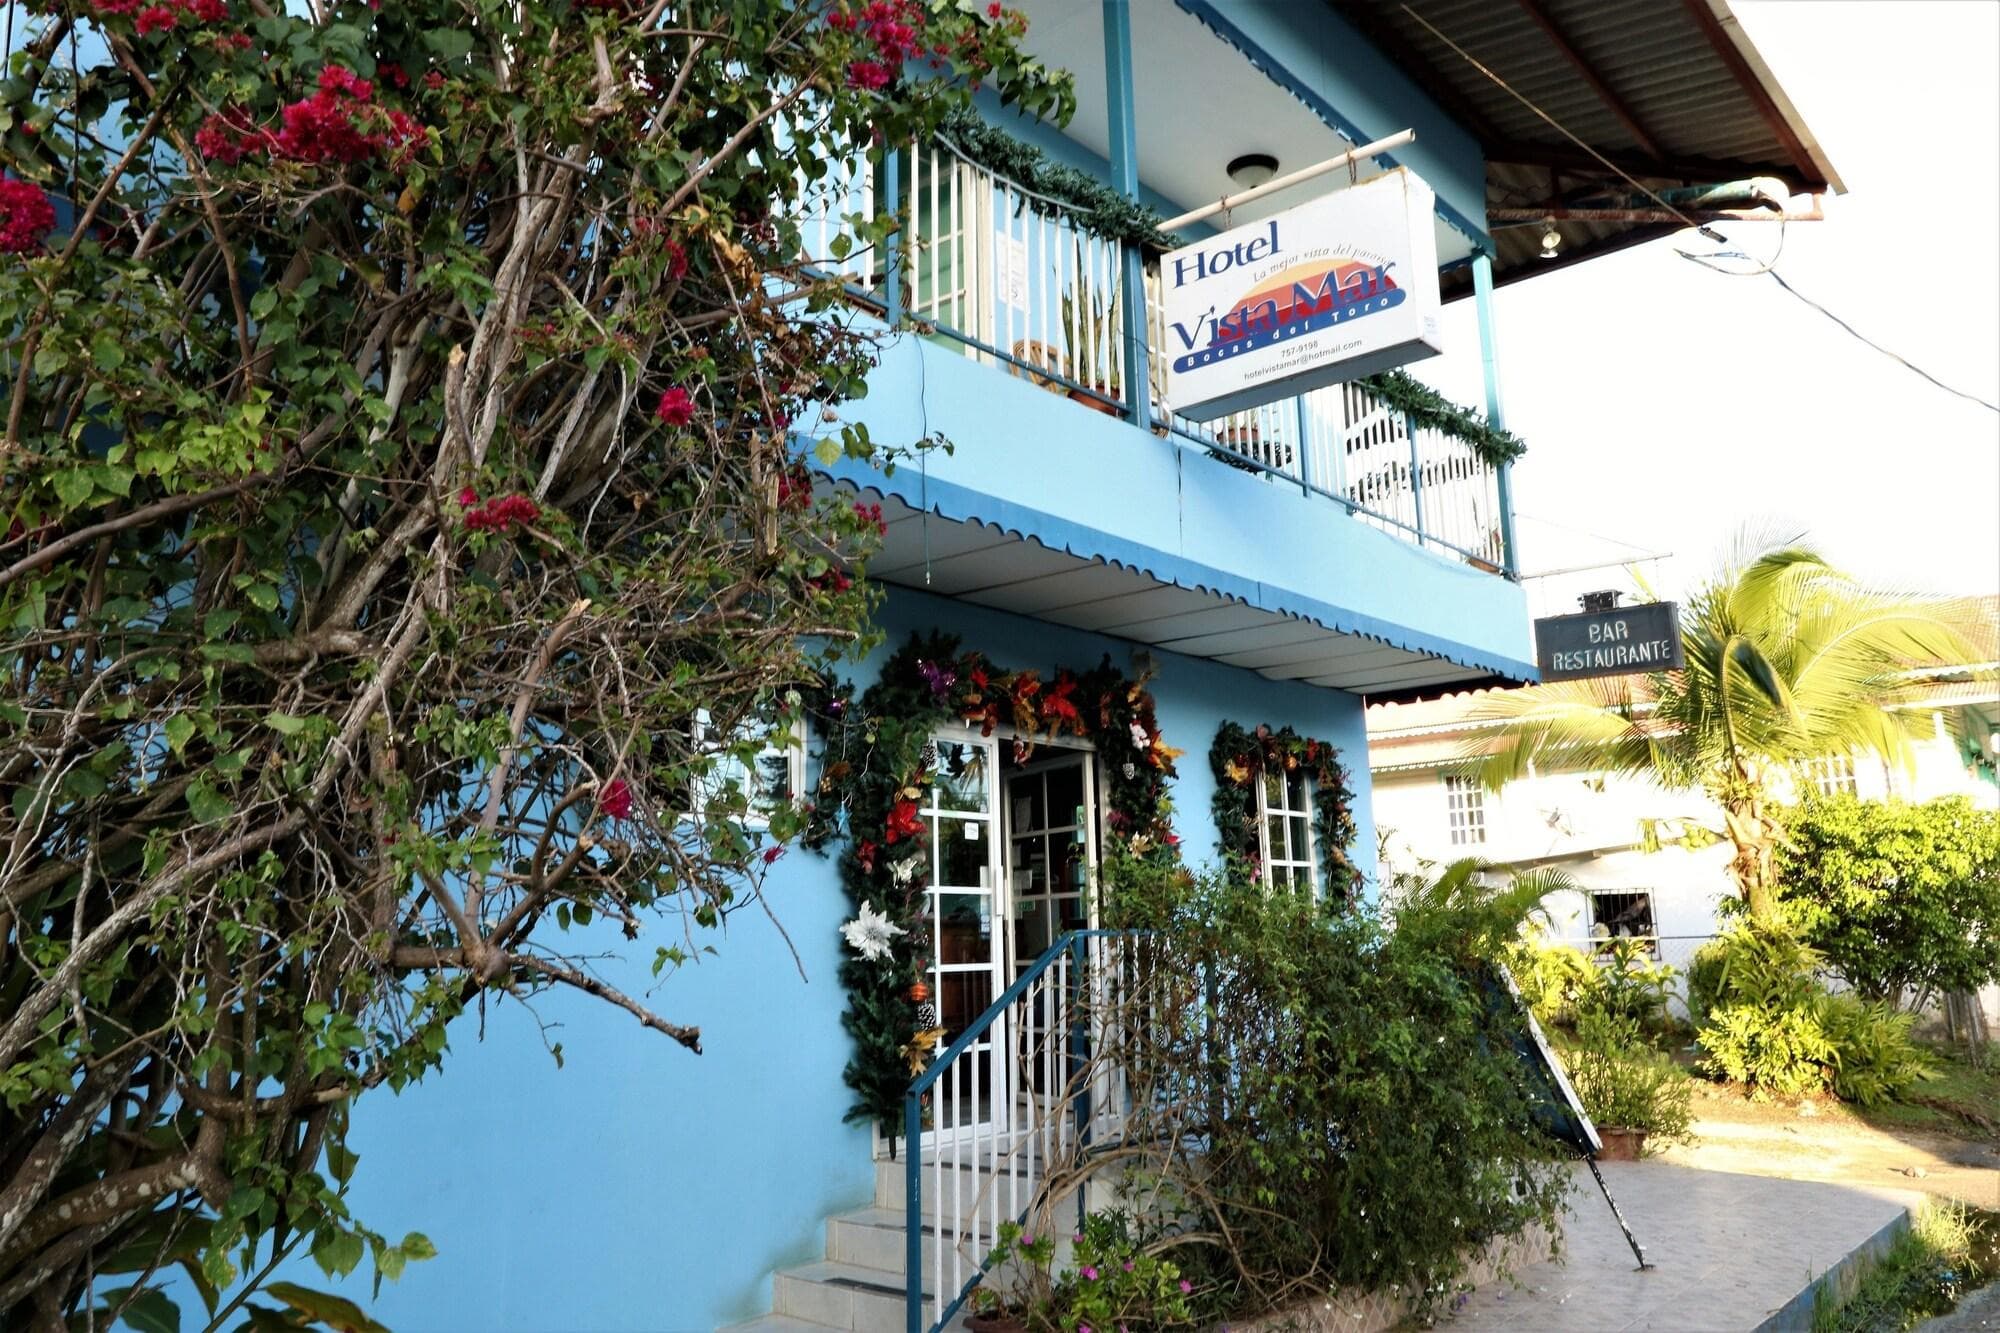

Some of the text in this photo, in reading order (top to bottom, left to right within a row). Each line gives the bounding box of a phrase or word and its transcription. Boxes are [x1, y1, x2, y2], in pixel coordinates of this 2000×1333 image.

[1172, 220, 1282, 289] Hotel
[1253, 271, 1266, 283] La
[1270, 254, 1299, 272] mejor
[1304, 247, 1329, 259] vista
[1333, 243, 1351, 256] del
[1168, 261, 1396, 351] Vista Mar
[1187, 298, 1388, 367] Bocas del Toro
[1244, 338, 1363, 380] hotelvistamar@hotmail.com
[1588, 620, 1629, 644] BAR
[1552, 639, 1672, 671] RESTAURANTE
